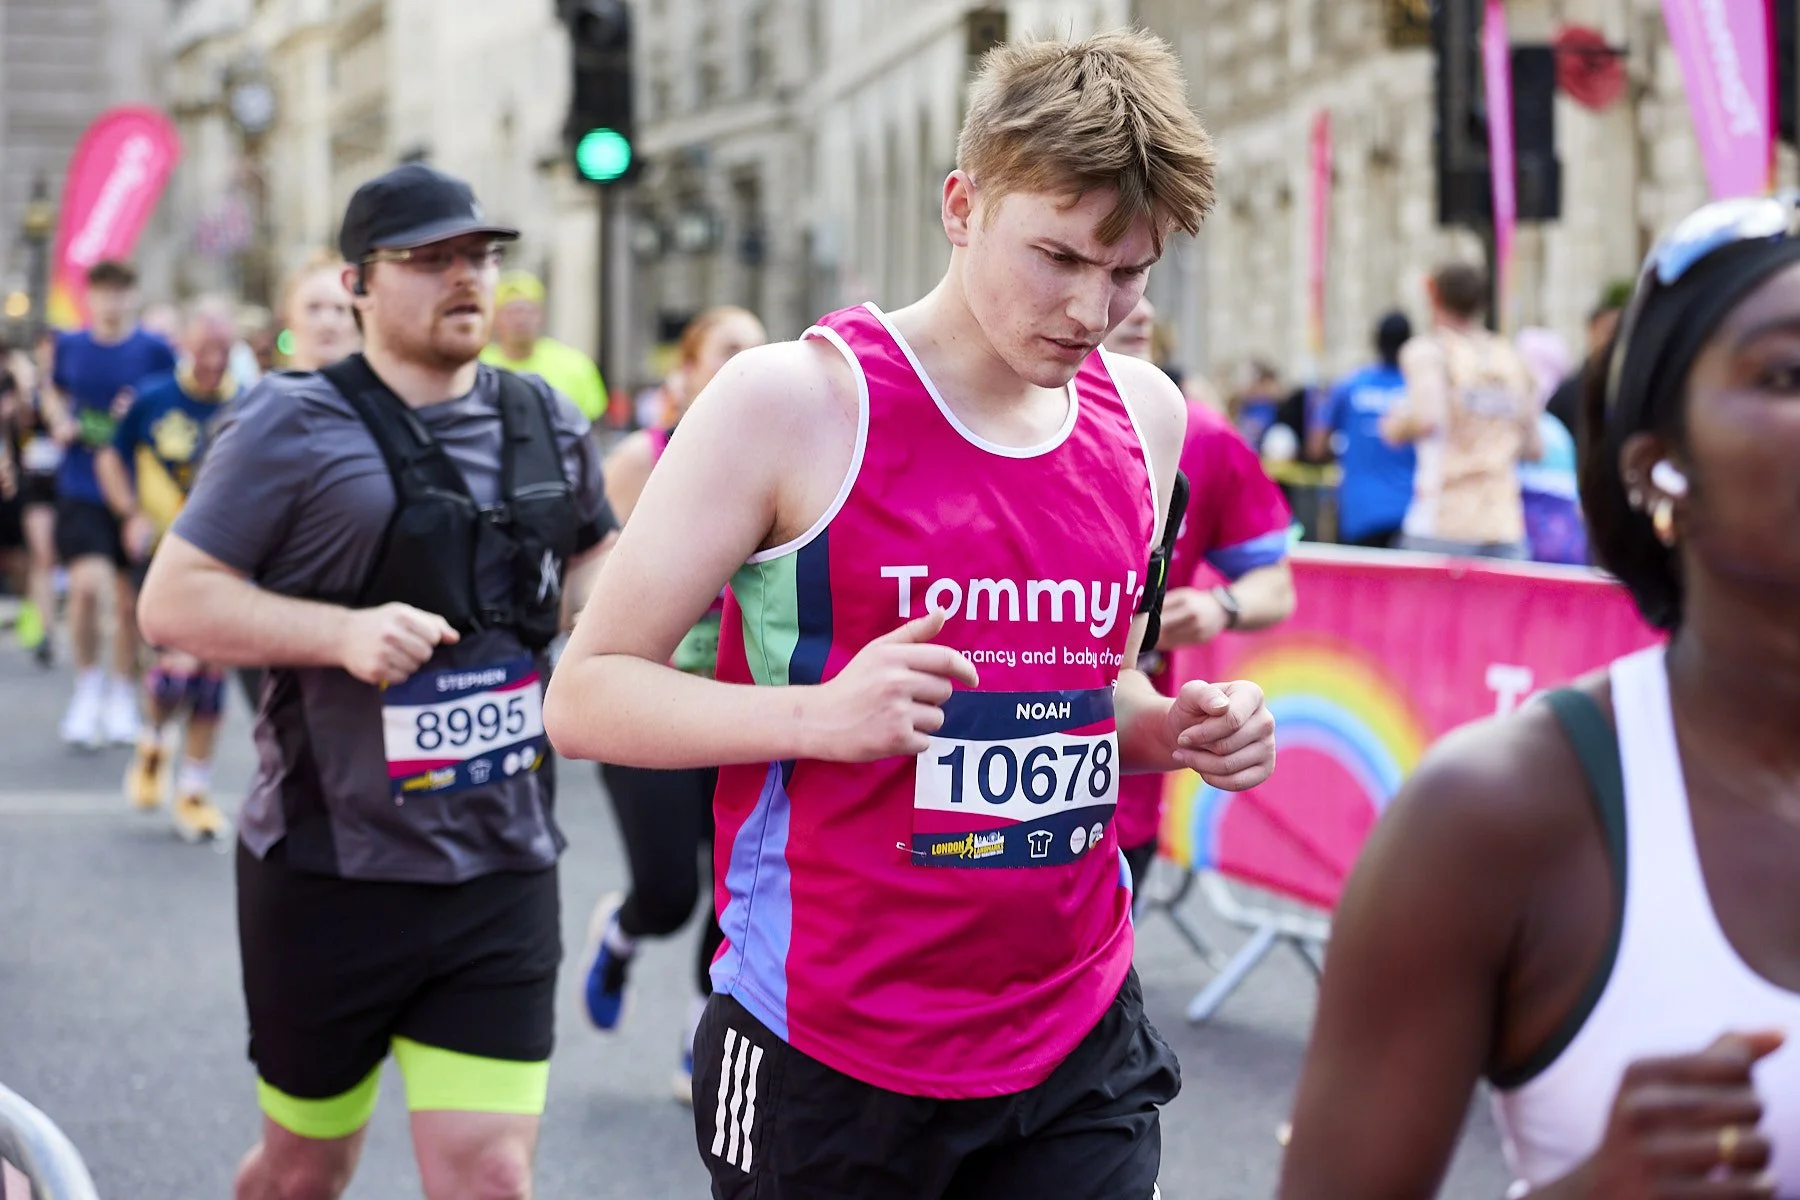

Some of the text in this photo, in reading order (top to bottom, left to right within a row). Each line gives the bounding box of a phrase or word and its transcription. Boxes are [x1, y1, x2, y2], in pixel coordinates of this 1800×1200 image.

[959, 649, 1017, 668] nancy
[1021, 646, 1056, 665] and
[1063, 646, 1098, 669] baby
[436, 668, 507, 692] STEPHEN
[1016, 701, 1071, 720] NOAH
[416, 696, 525, 750] 8995
[937, 739, 1112, 804] 10678
[931, 840, 965, 855] LONDON
